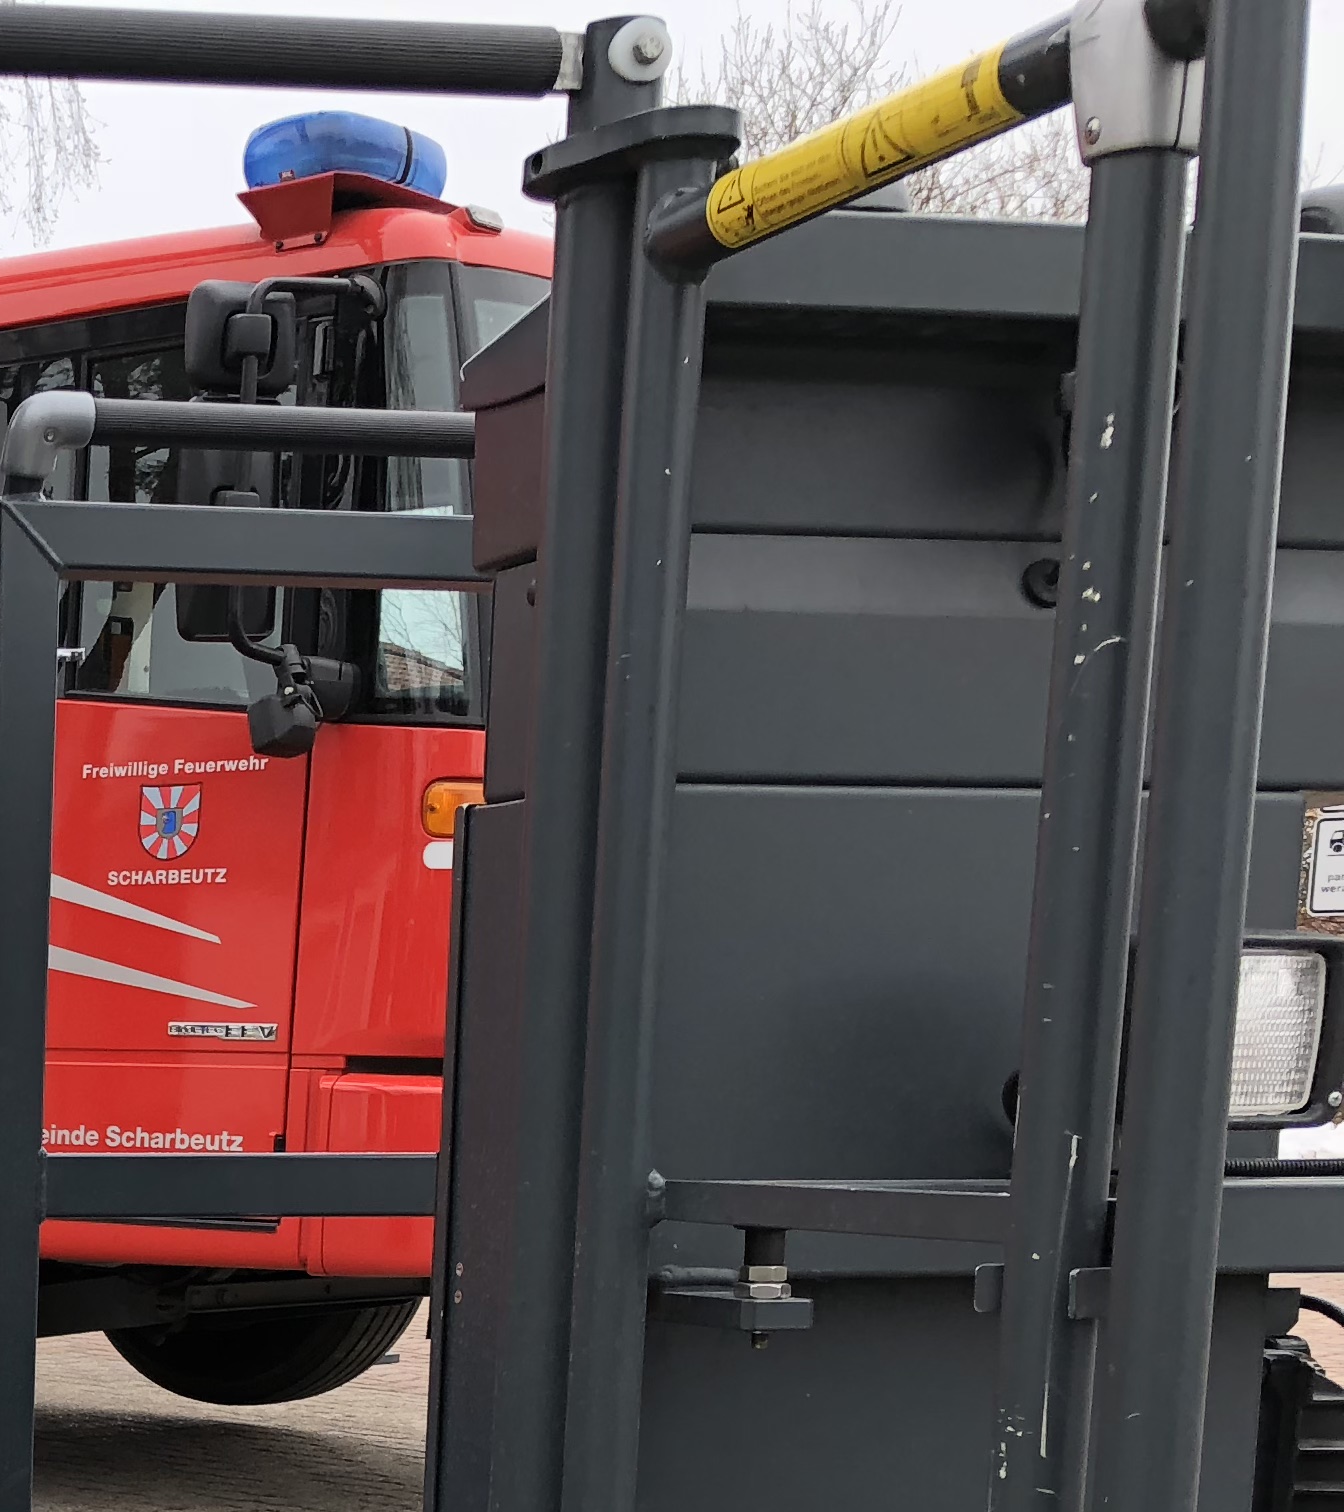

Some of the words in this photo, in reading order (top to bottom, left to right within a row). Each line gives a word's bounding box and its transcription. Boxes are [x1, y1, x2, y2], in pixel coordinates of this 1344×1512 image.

[82, 761, 169, 779] Freiwillige
[174, 755, 269, 774] Feuerwehr
[107, 868, 227, 886] SCHARBEUTZ
[41, 1124, 99, 1147] einde
[105, 1125, 244, 1151] Scharbeutz
